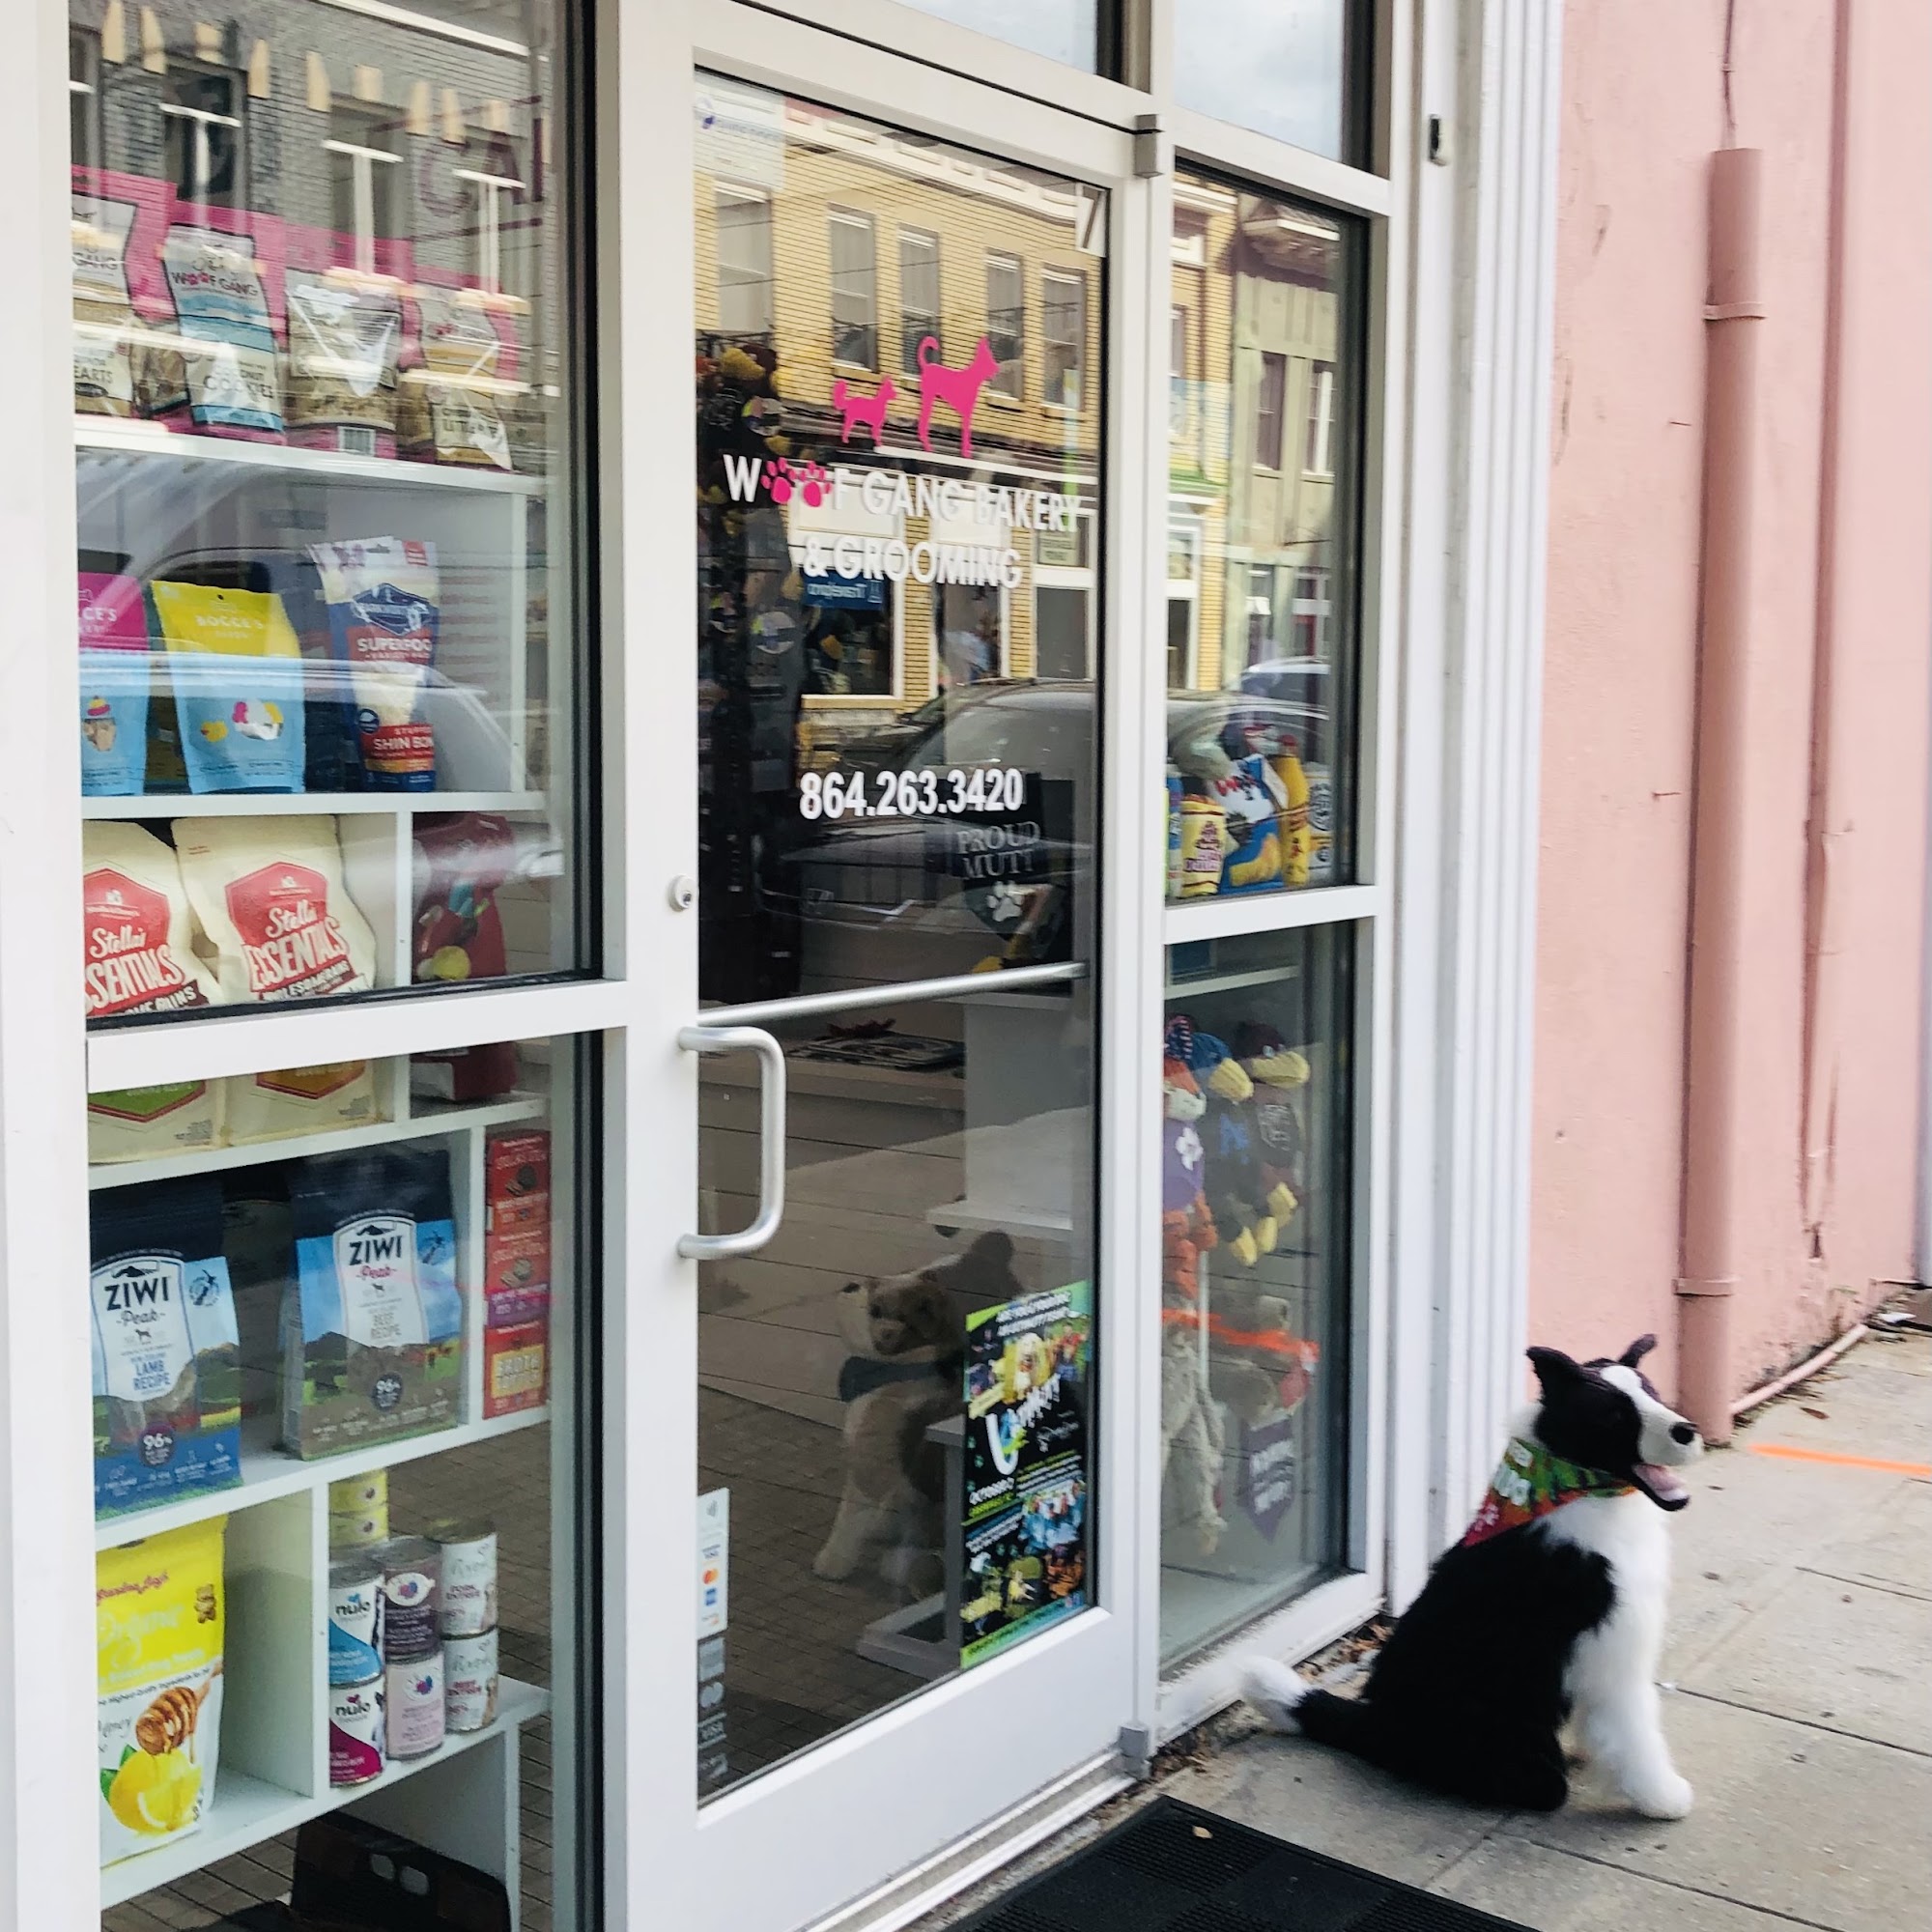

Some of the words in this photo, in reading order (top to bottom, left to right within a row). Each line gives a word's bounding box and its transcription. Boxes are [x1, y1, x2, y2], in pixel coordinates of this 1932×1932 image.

[862, 469, 967, 524] GANG
[973, 485, 1084, 533] BAKERY
[803, 536, 830, 578] &
[833, 535, 1024, 589] GROOMING
[800, 768, 1025, 819] 864.263.3420
[956, 820, 1042, 855] PROUD
[349, 1236, 403, 1266] ZIWI
[104, 1276, 169, 1312] ZIWI
[334, 1597, 372, 1616] nulo
[334, 1698, 372, 1718] nulo
